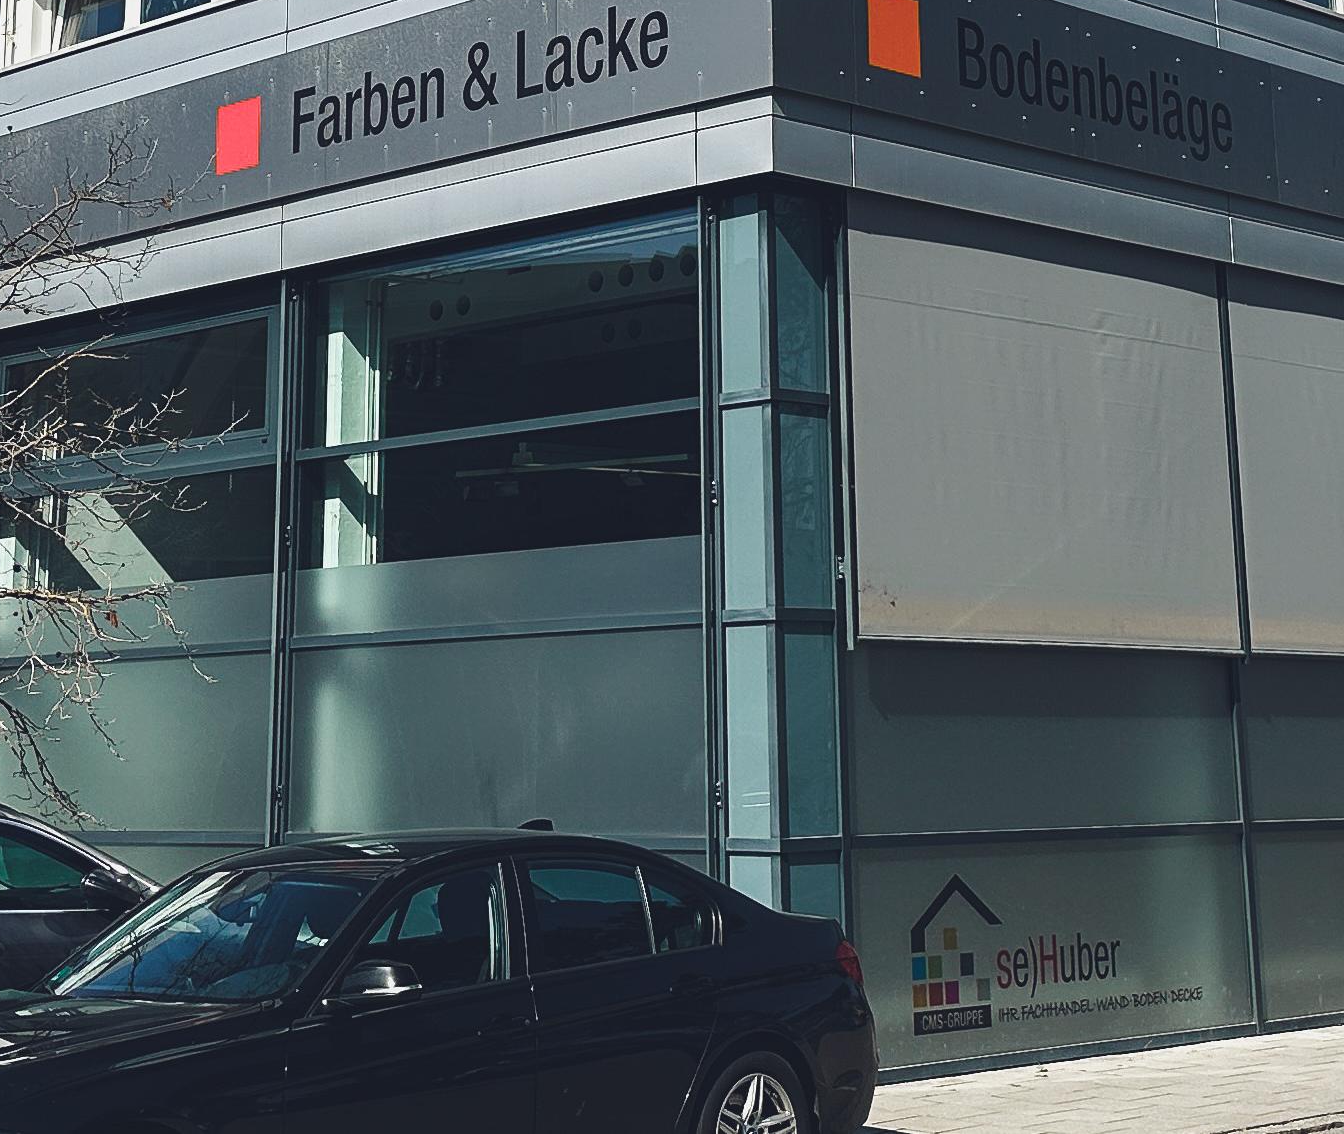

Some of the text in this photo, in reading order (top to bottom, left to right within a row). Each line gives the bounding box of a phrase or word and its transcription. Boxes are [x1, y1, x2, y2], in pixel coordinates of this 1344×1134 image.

[290, 5, 670, 154] Farben & Lacke
[956, 16, 1234, 163] Bodenbeläge
[922, 1009, 984, 1032] CMS-GRUPPE
[998, 1006, 1019, 1023] IHR
[1171, 986, 1204, 1002] DECKE
